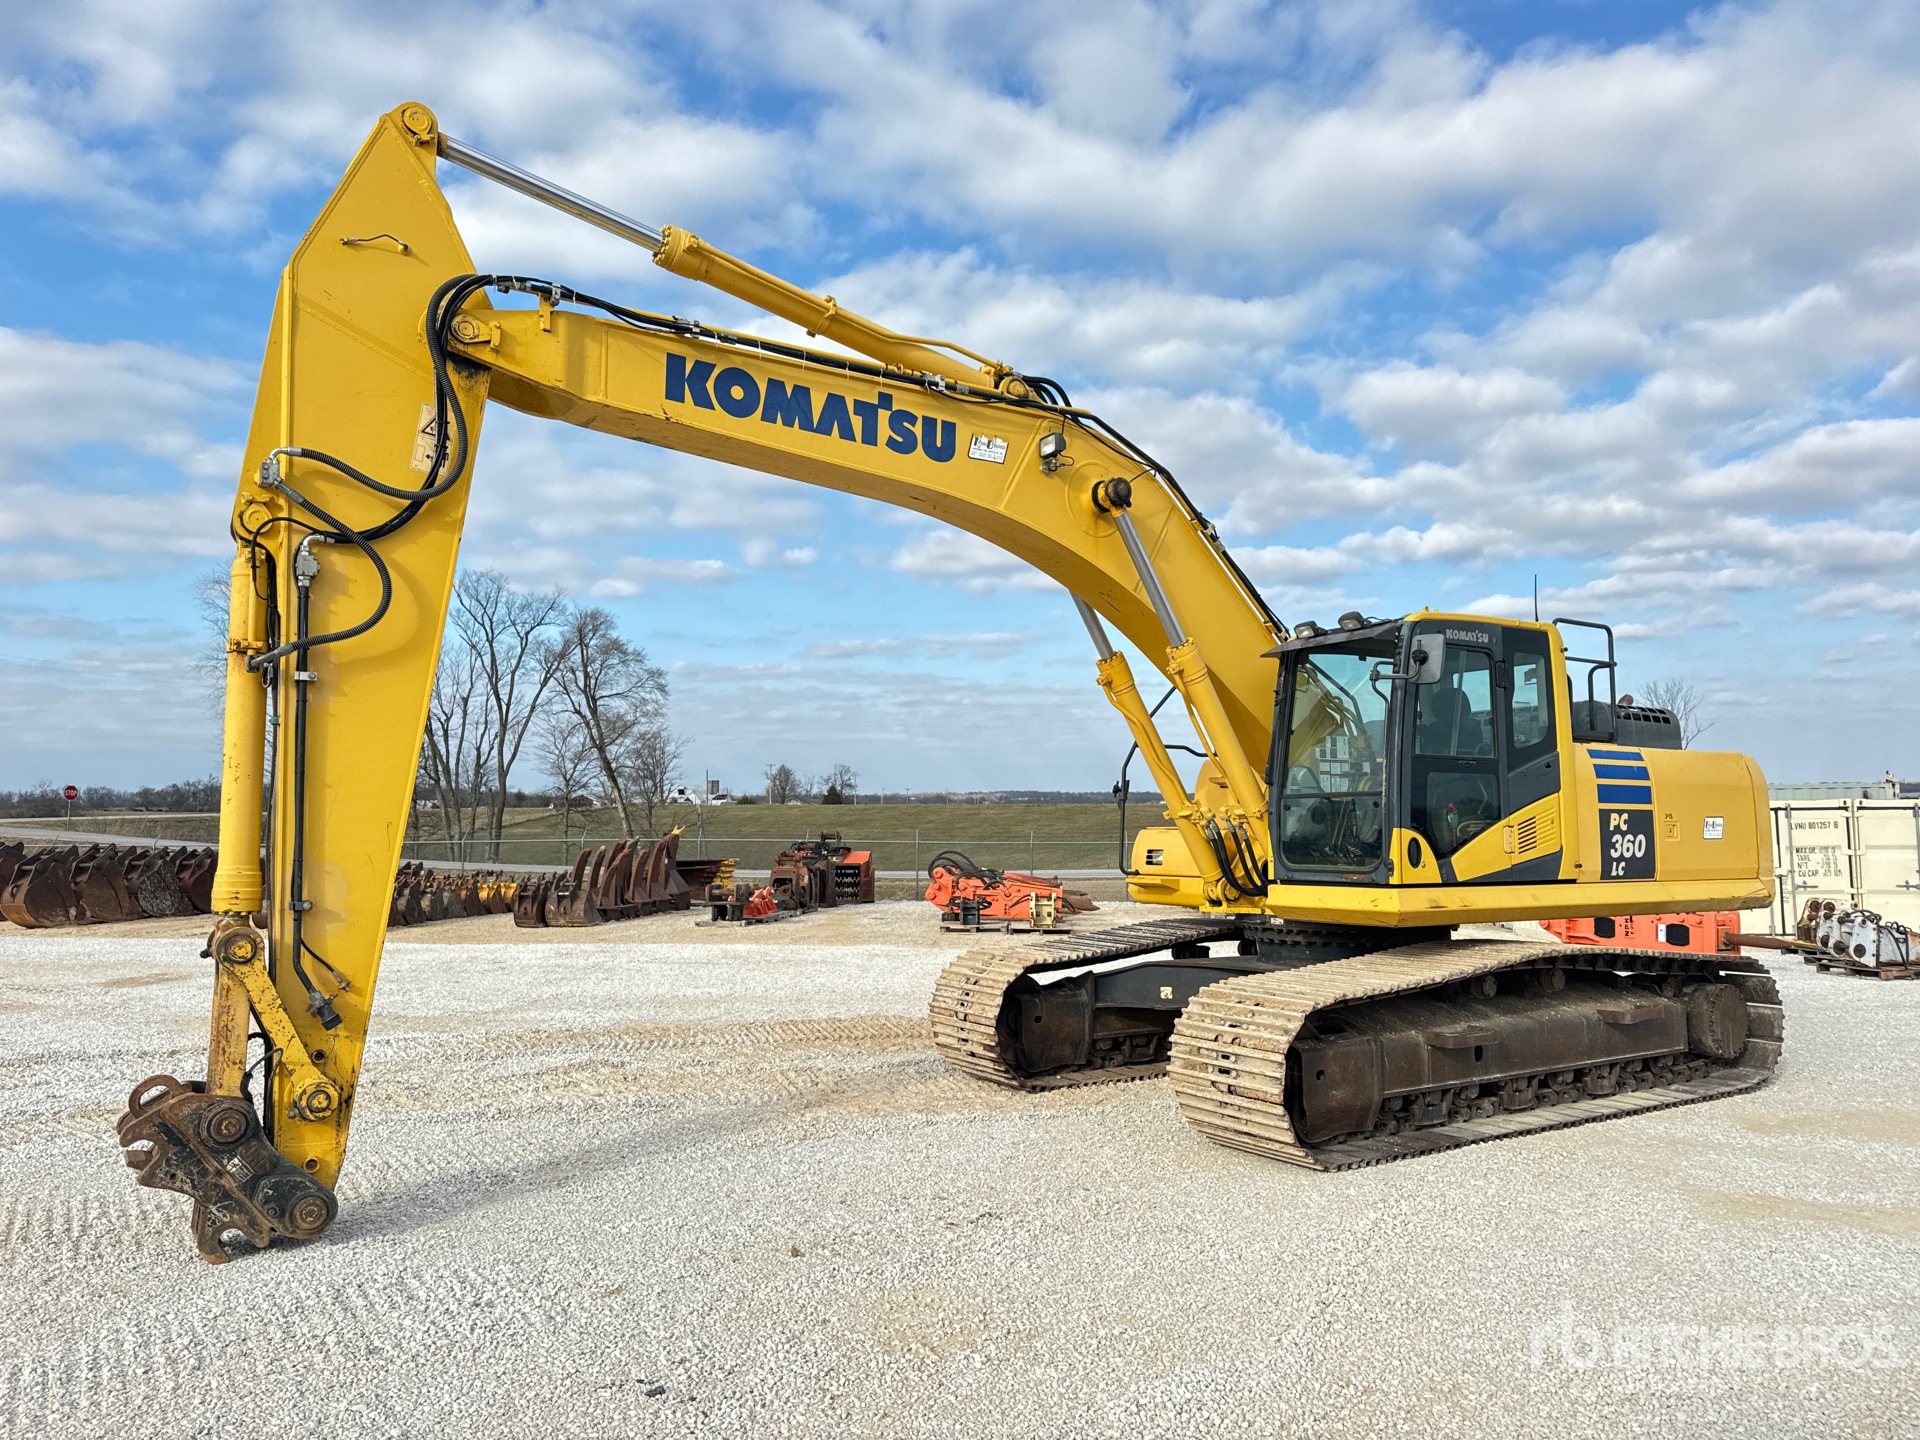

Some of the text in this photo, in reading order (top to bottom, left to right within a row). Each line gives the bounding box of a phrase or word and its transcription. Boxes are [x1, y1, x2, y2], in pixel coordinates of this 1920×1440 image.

[665, 352, 957, 463] KOMATSU
[1445, 628, 1489, 643] KOMATSU
[1609, 812, 1629, 831] PC
[1808, 821, 1831, 830] 801257
[1610, 833, 1647, 858] 360
[1610, 861, 1626, 876] LC
